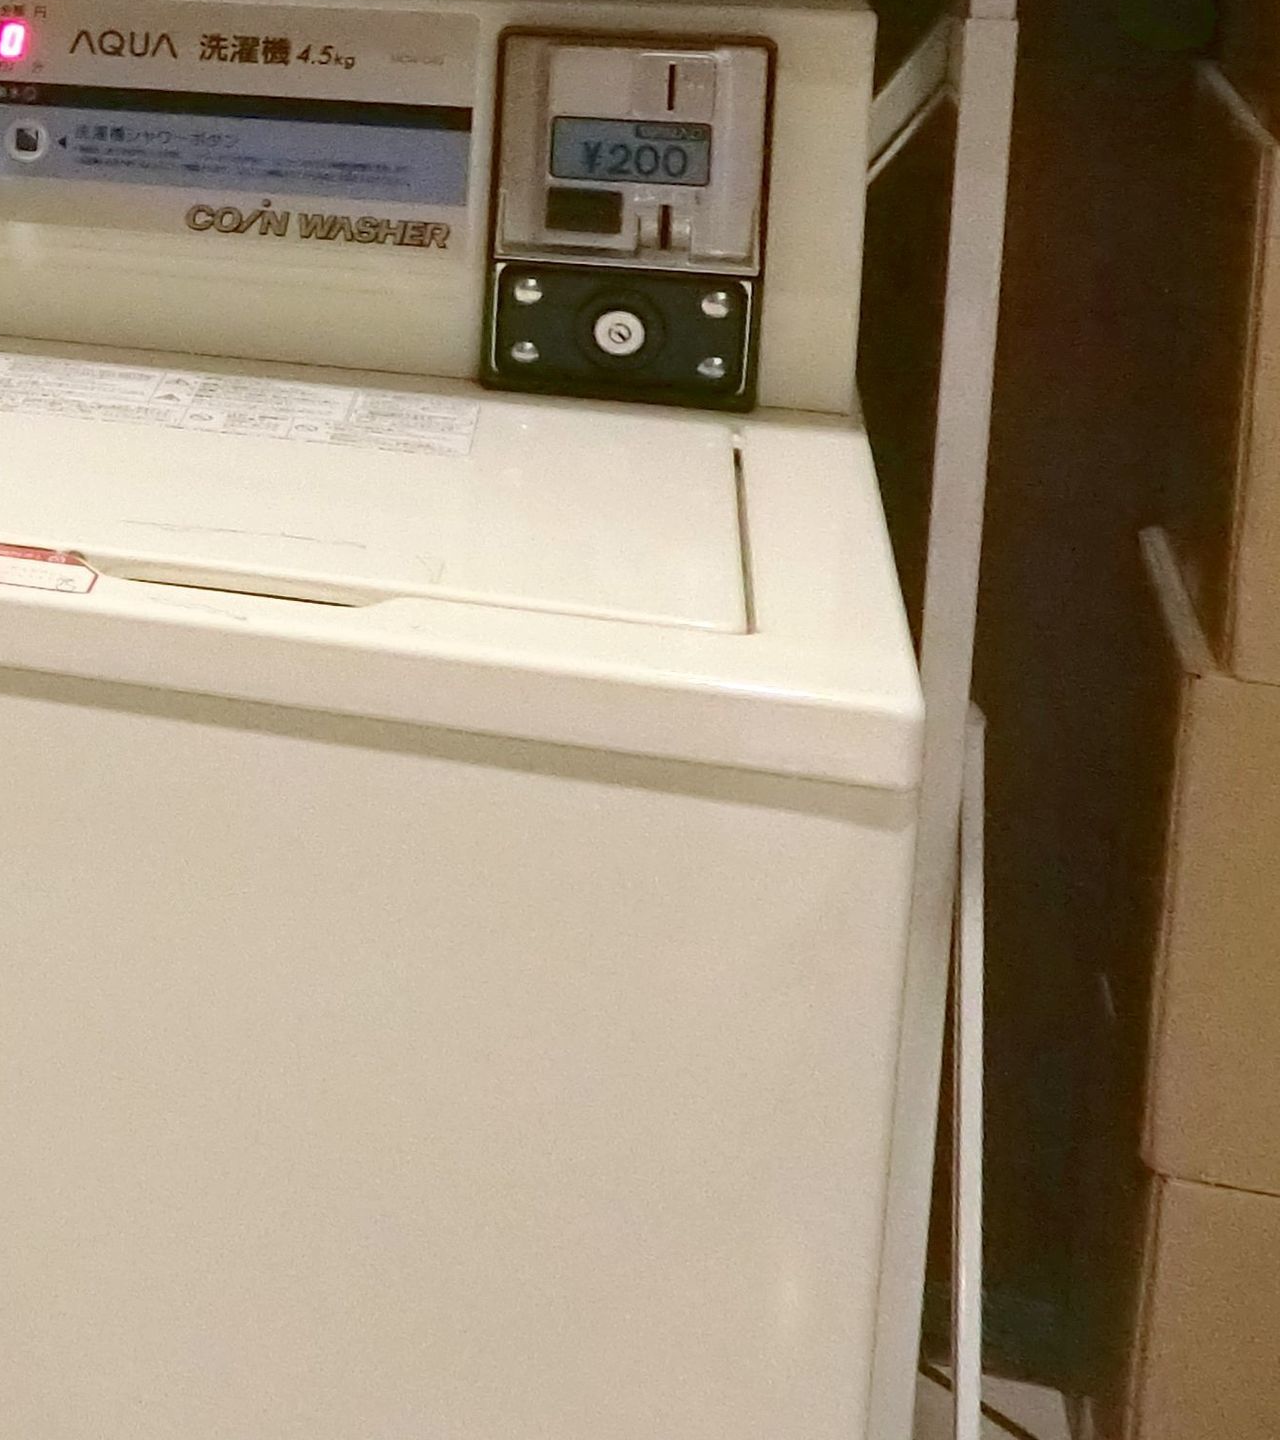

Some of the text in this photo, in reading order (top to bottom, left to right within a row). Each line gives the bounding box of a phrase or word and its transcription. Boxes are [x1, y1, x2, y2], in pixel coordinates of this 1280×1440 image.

[34, 5, 47, 19] 円
[0, 22, 25, 57] 0
[70, 30, 355, 70] AQUA 洗濯機 4.5kg
[581, 140, 689, 178] ¥200
[185, 198, 450, 250] COIN WASHER
